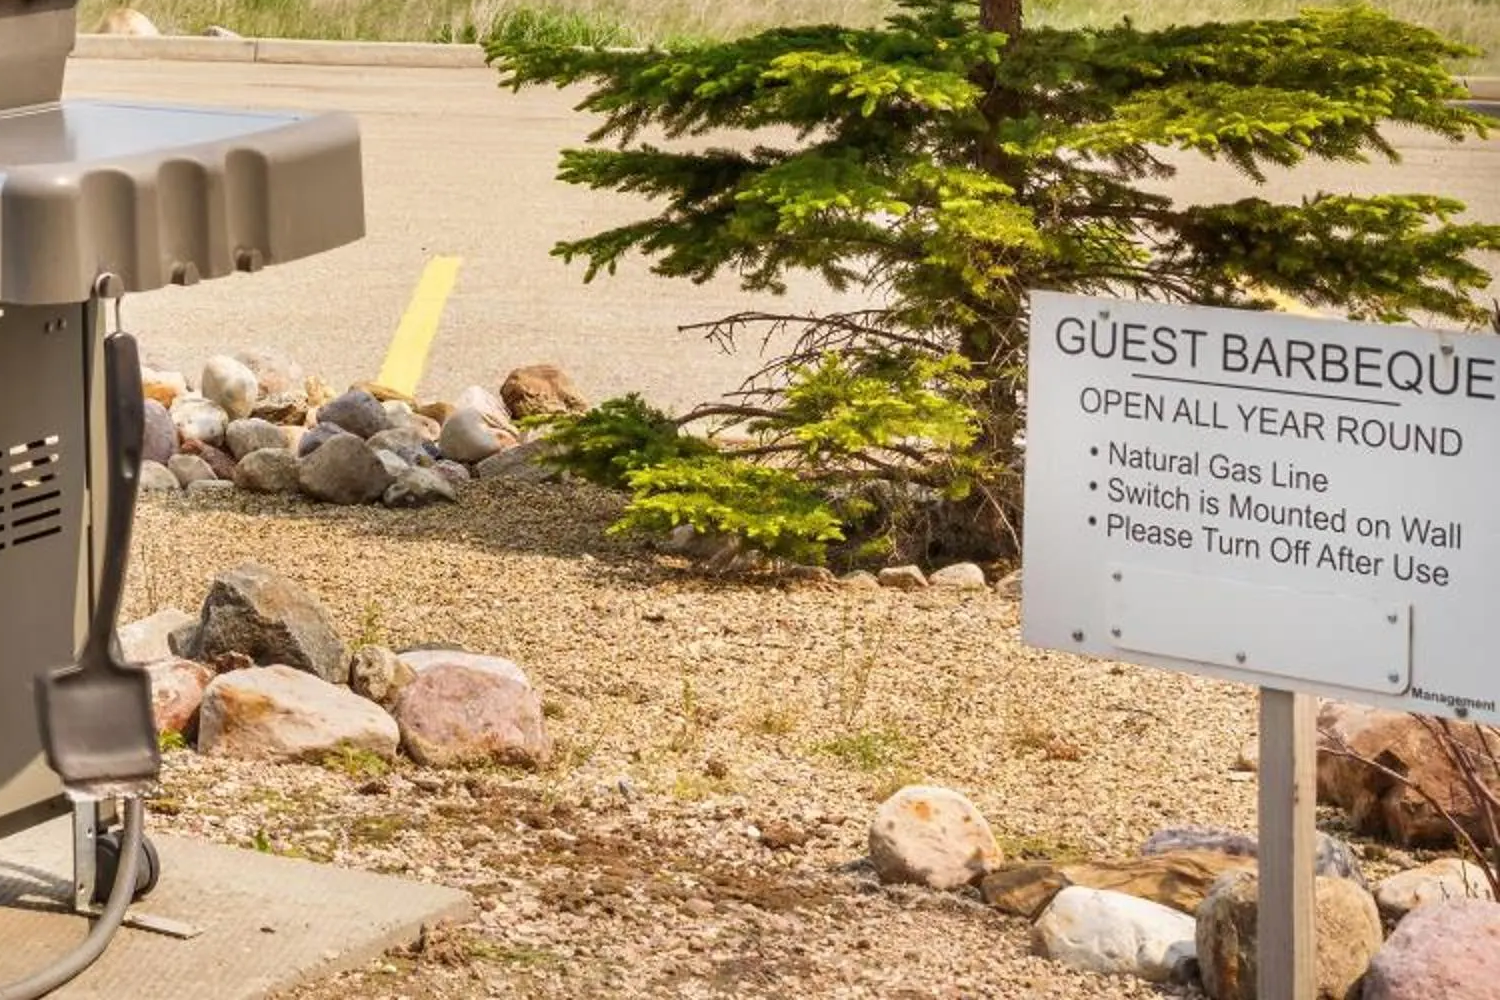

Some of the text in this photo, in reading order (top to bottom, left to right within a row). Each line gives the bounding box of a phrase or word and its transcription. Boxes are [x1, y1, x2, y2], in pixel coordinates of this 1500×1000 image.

[1055, 316, 1496, 400] GUEST BARBEQUE
[1080, 386, 1463, 457] OPEN ALL YEAR ROUND
[1108, 440, 1329, 493] Natural Gas Line
[1107, 476, 1462, 550] Switch is Mounted on Wall
[1106, 512, 1450, 587] Please Turn Off After Use
[1411, 687, 1496, 712] Management
